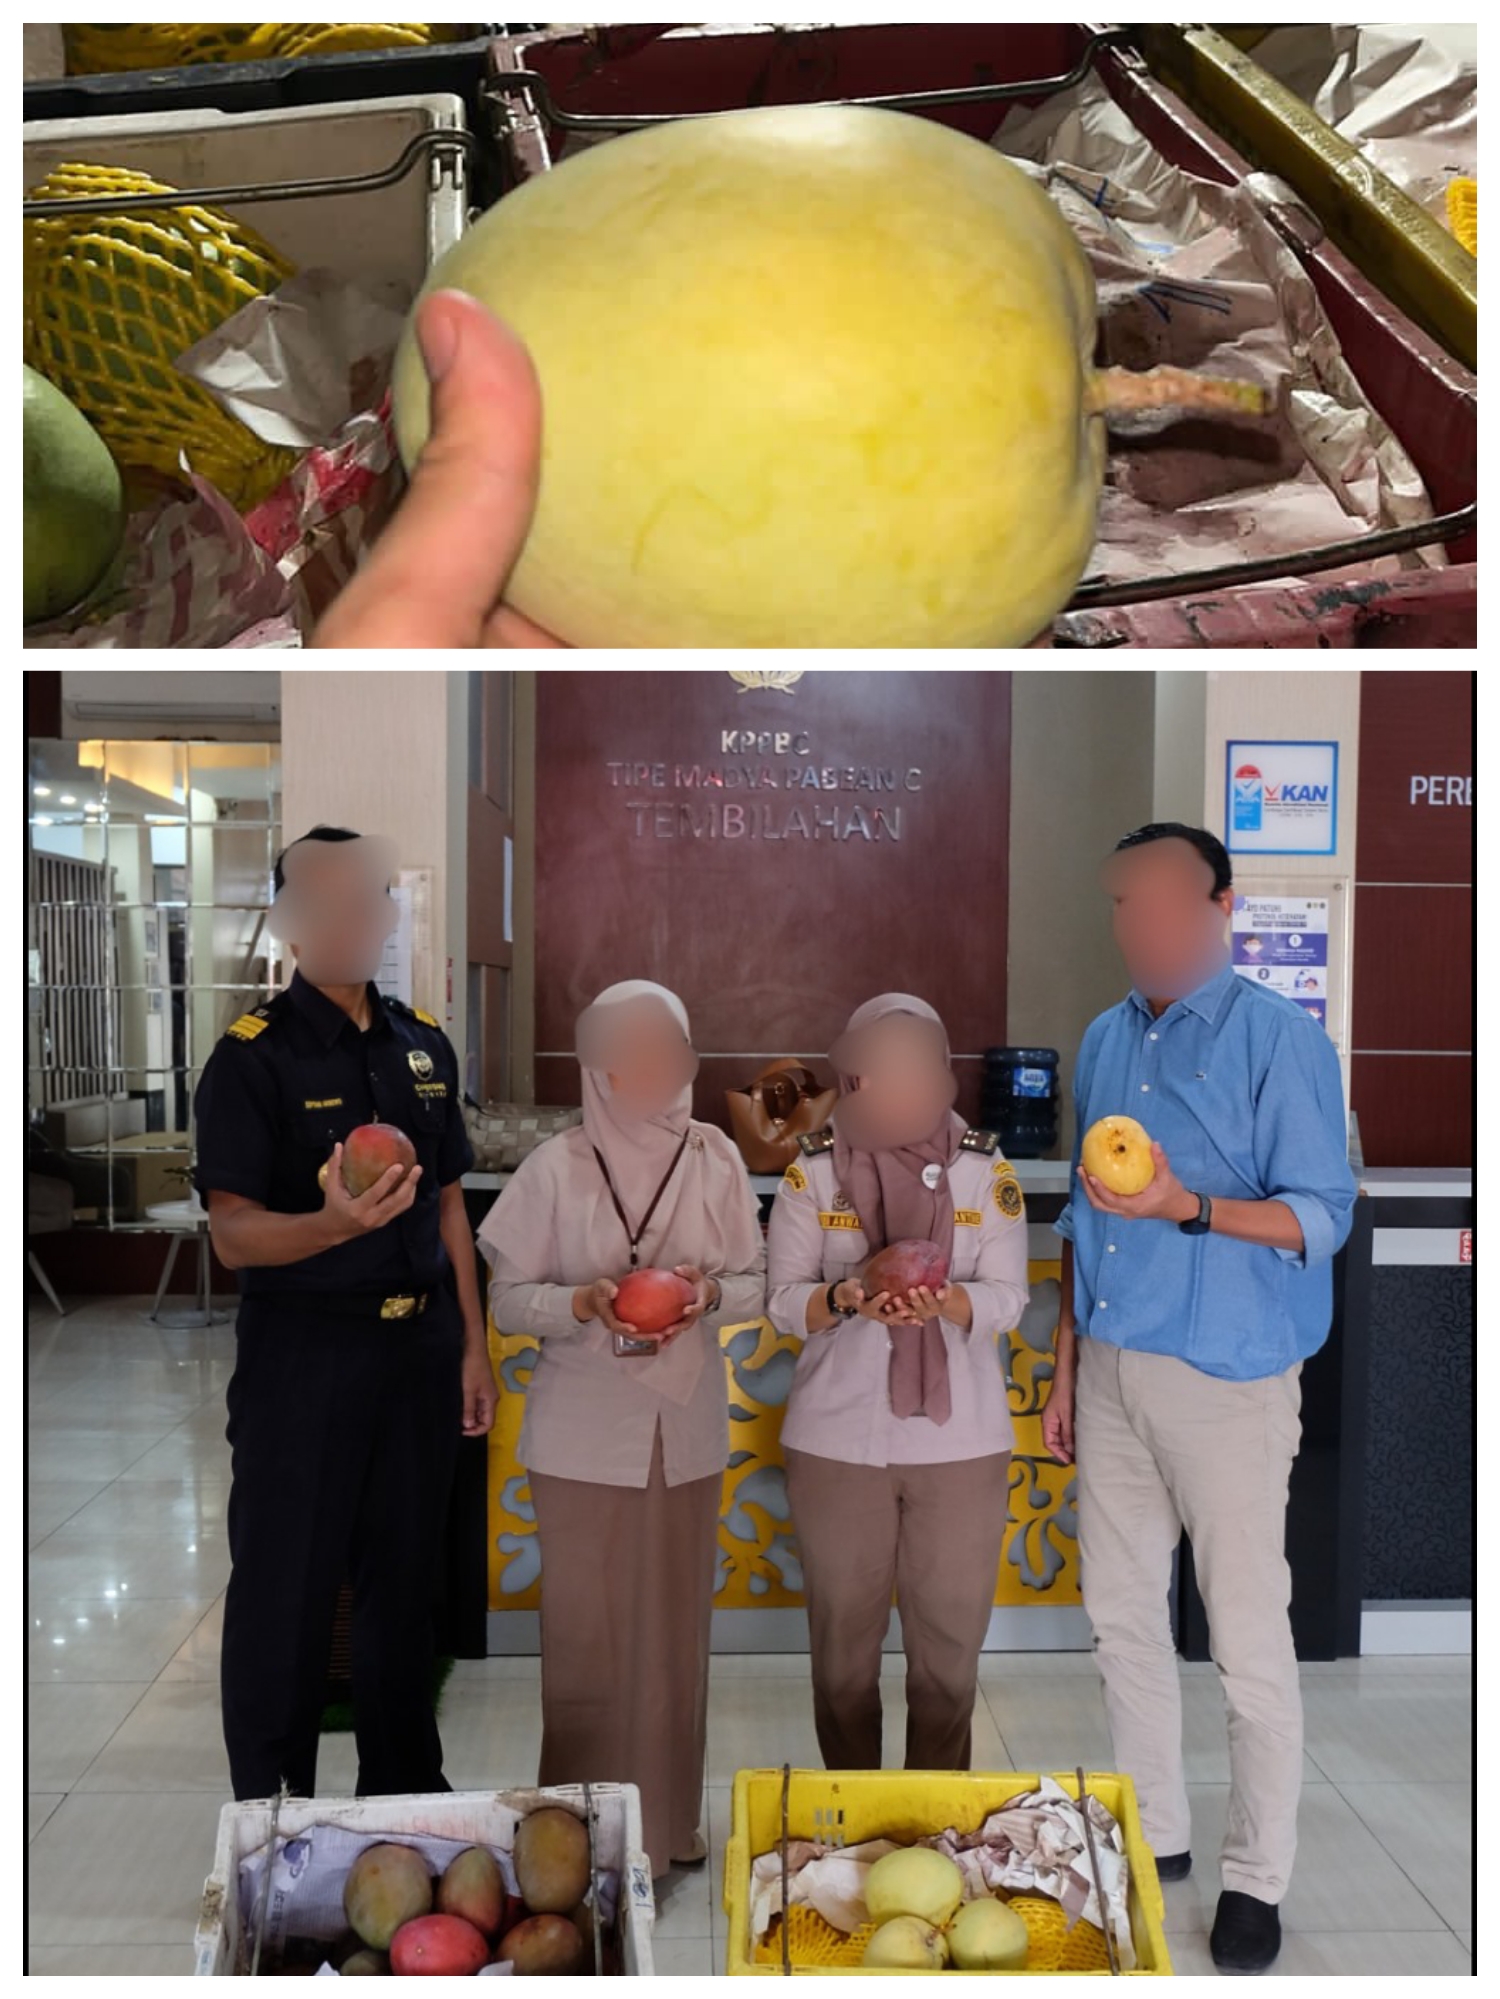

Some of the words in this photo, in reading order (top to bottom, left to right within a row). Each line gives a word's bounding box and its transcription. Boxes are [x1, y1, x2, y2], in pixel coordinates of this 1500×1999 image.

[720, 730, 811, 755] KPPBC
[607, 762, 665, 788] TIPE
[675, 763, 778, 790] MADYA
[785, 766, 895, 792] PABEAN
[903, 768, 922, 792] C
[1281, 784, 1328, 801] KAN
[626, 801, 902, 842] TEMBILAHAN
